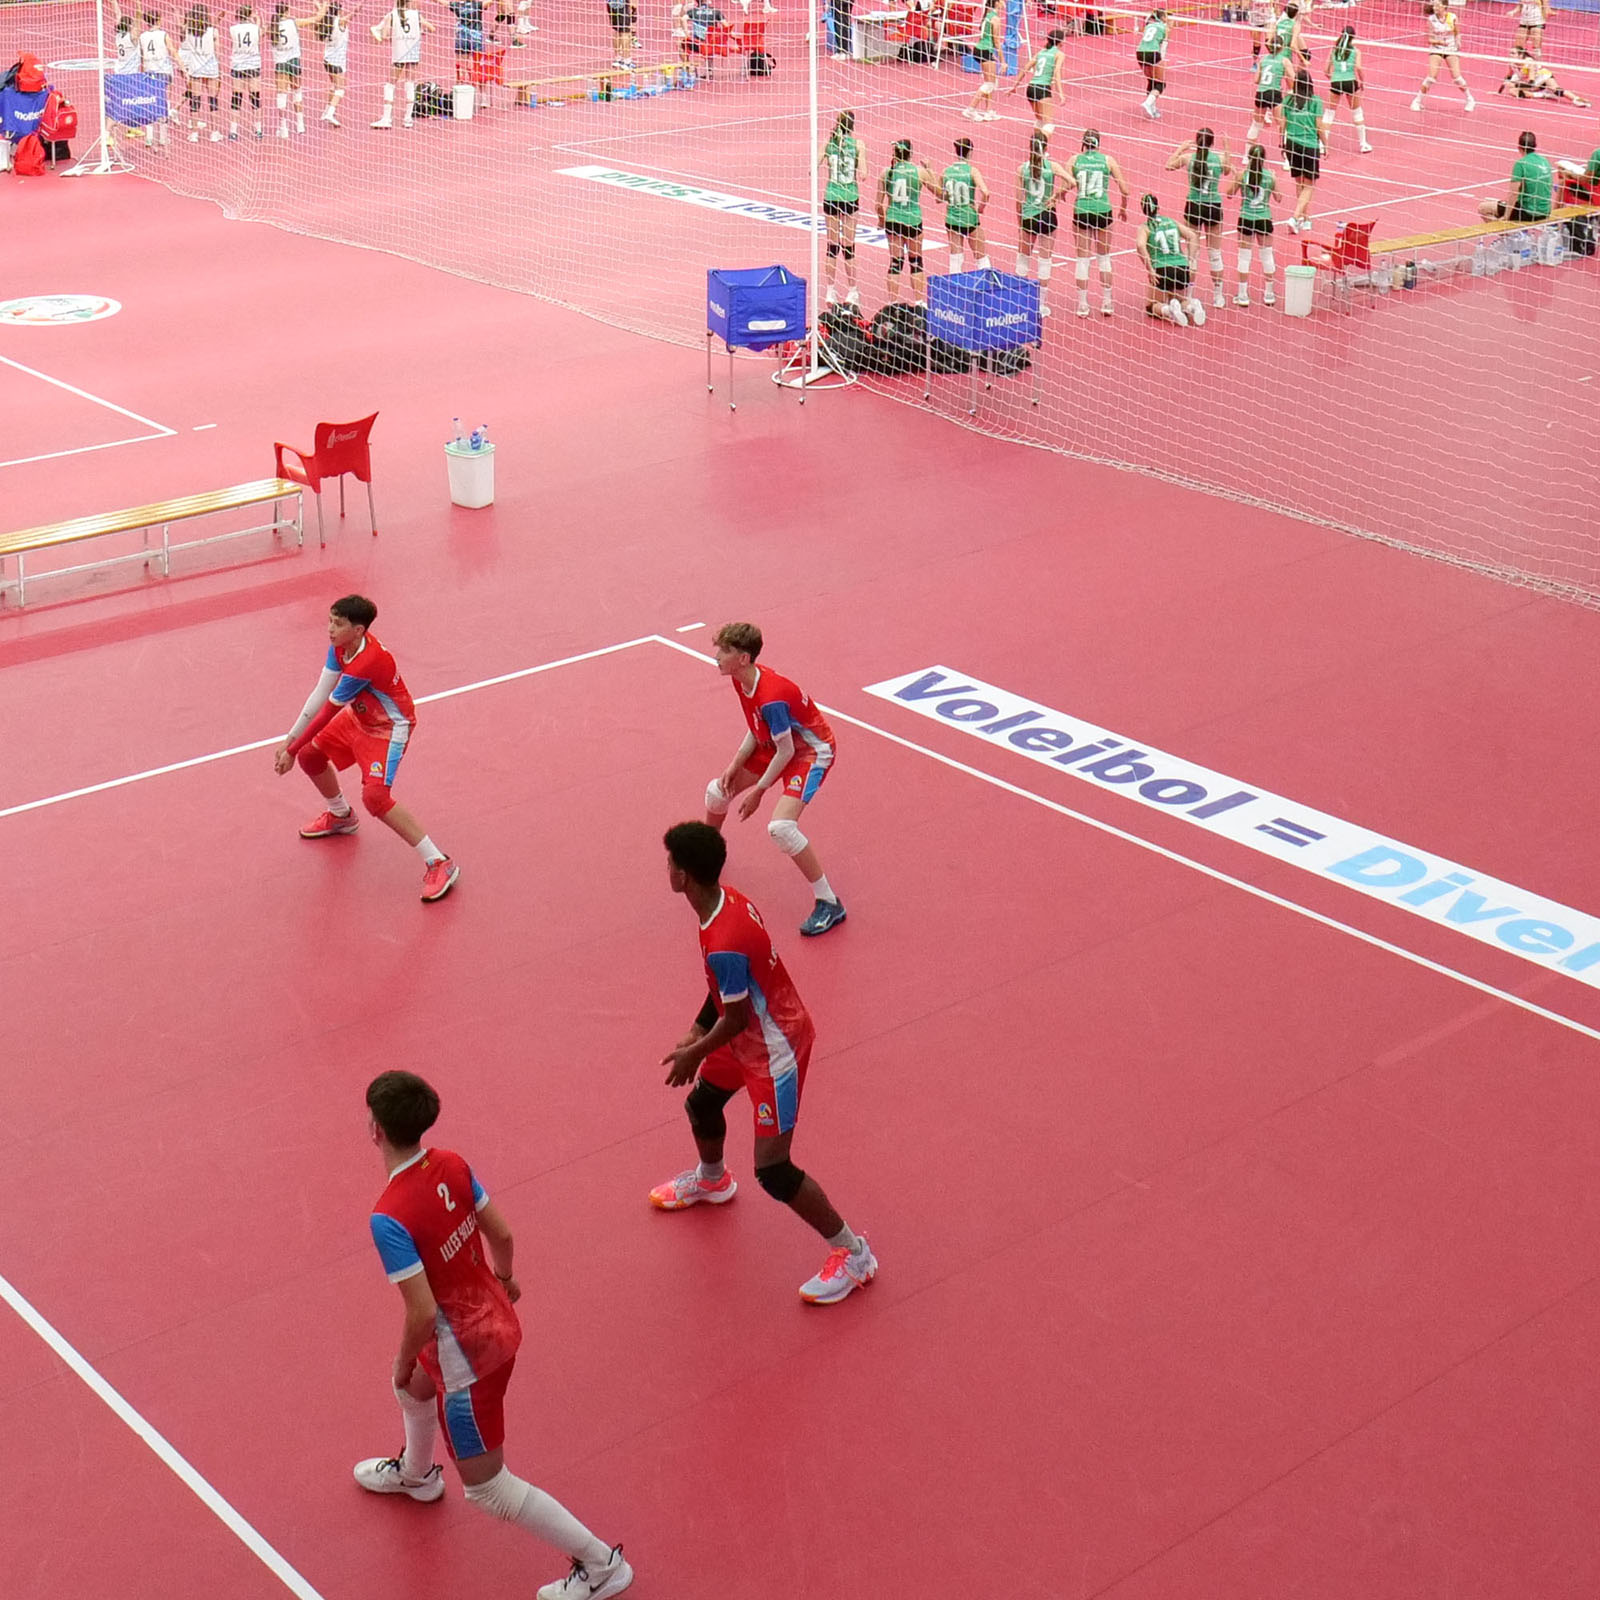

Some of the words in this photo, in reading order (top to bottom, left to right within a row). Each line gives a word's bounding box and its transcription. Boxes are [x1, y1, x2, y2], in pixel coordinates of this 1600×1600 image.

[147, 39, 155, 54] 4
[237, 31, 251, 48] 14
[1035, 57, 1046, 76] 3
[1261, 64, 1273, 85] 6
[122, 95, 156, 106] molten
[893, 178, 907, 202] 4
[945, 180, 970, 202] 10
[1076, 170, 1103, 197] 14
[934, 307, 965, 326] molten
[986, 314, 1028, 328] molten
[892, 671, 1262, 821] Voleibol
[437, 1182, 455, 1212] 2
